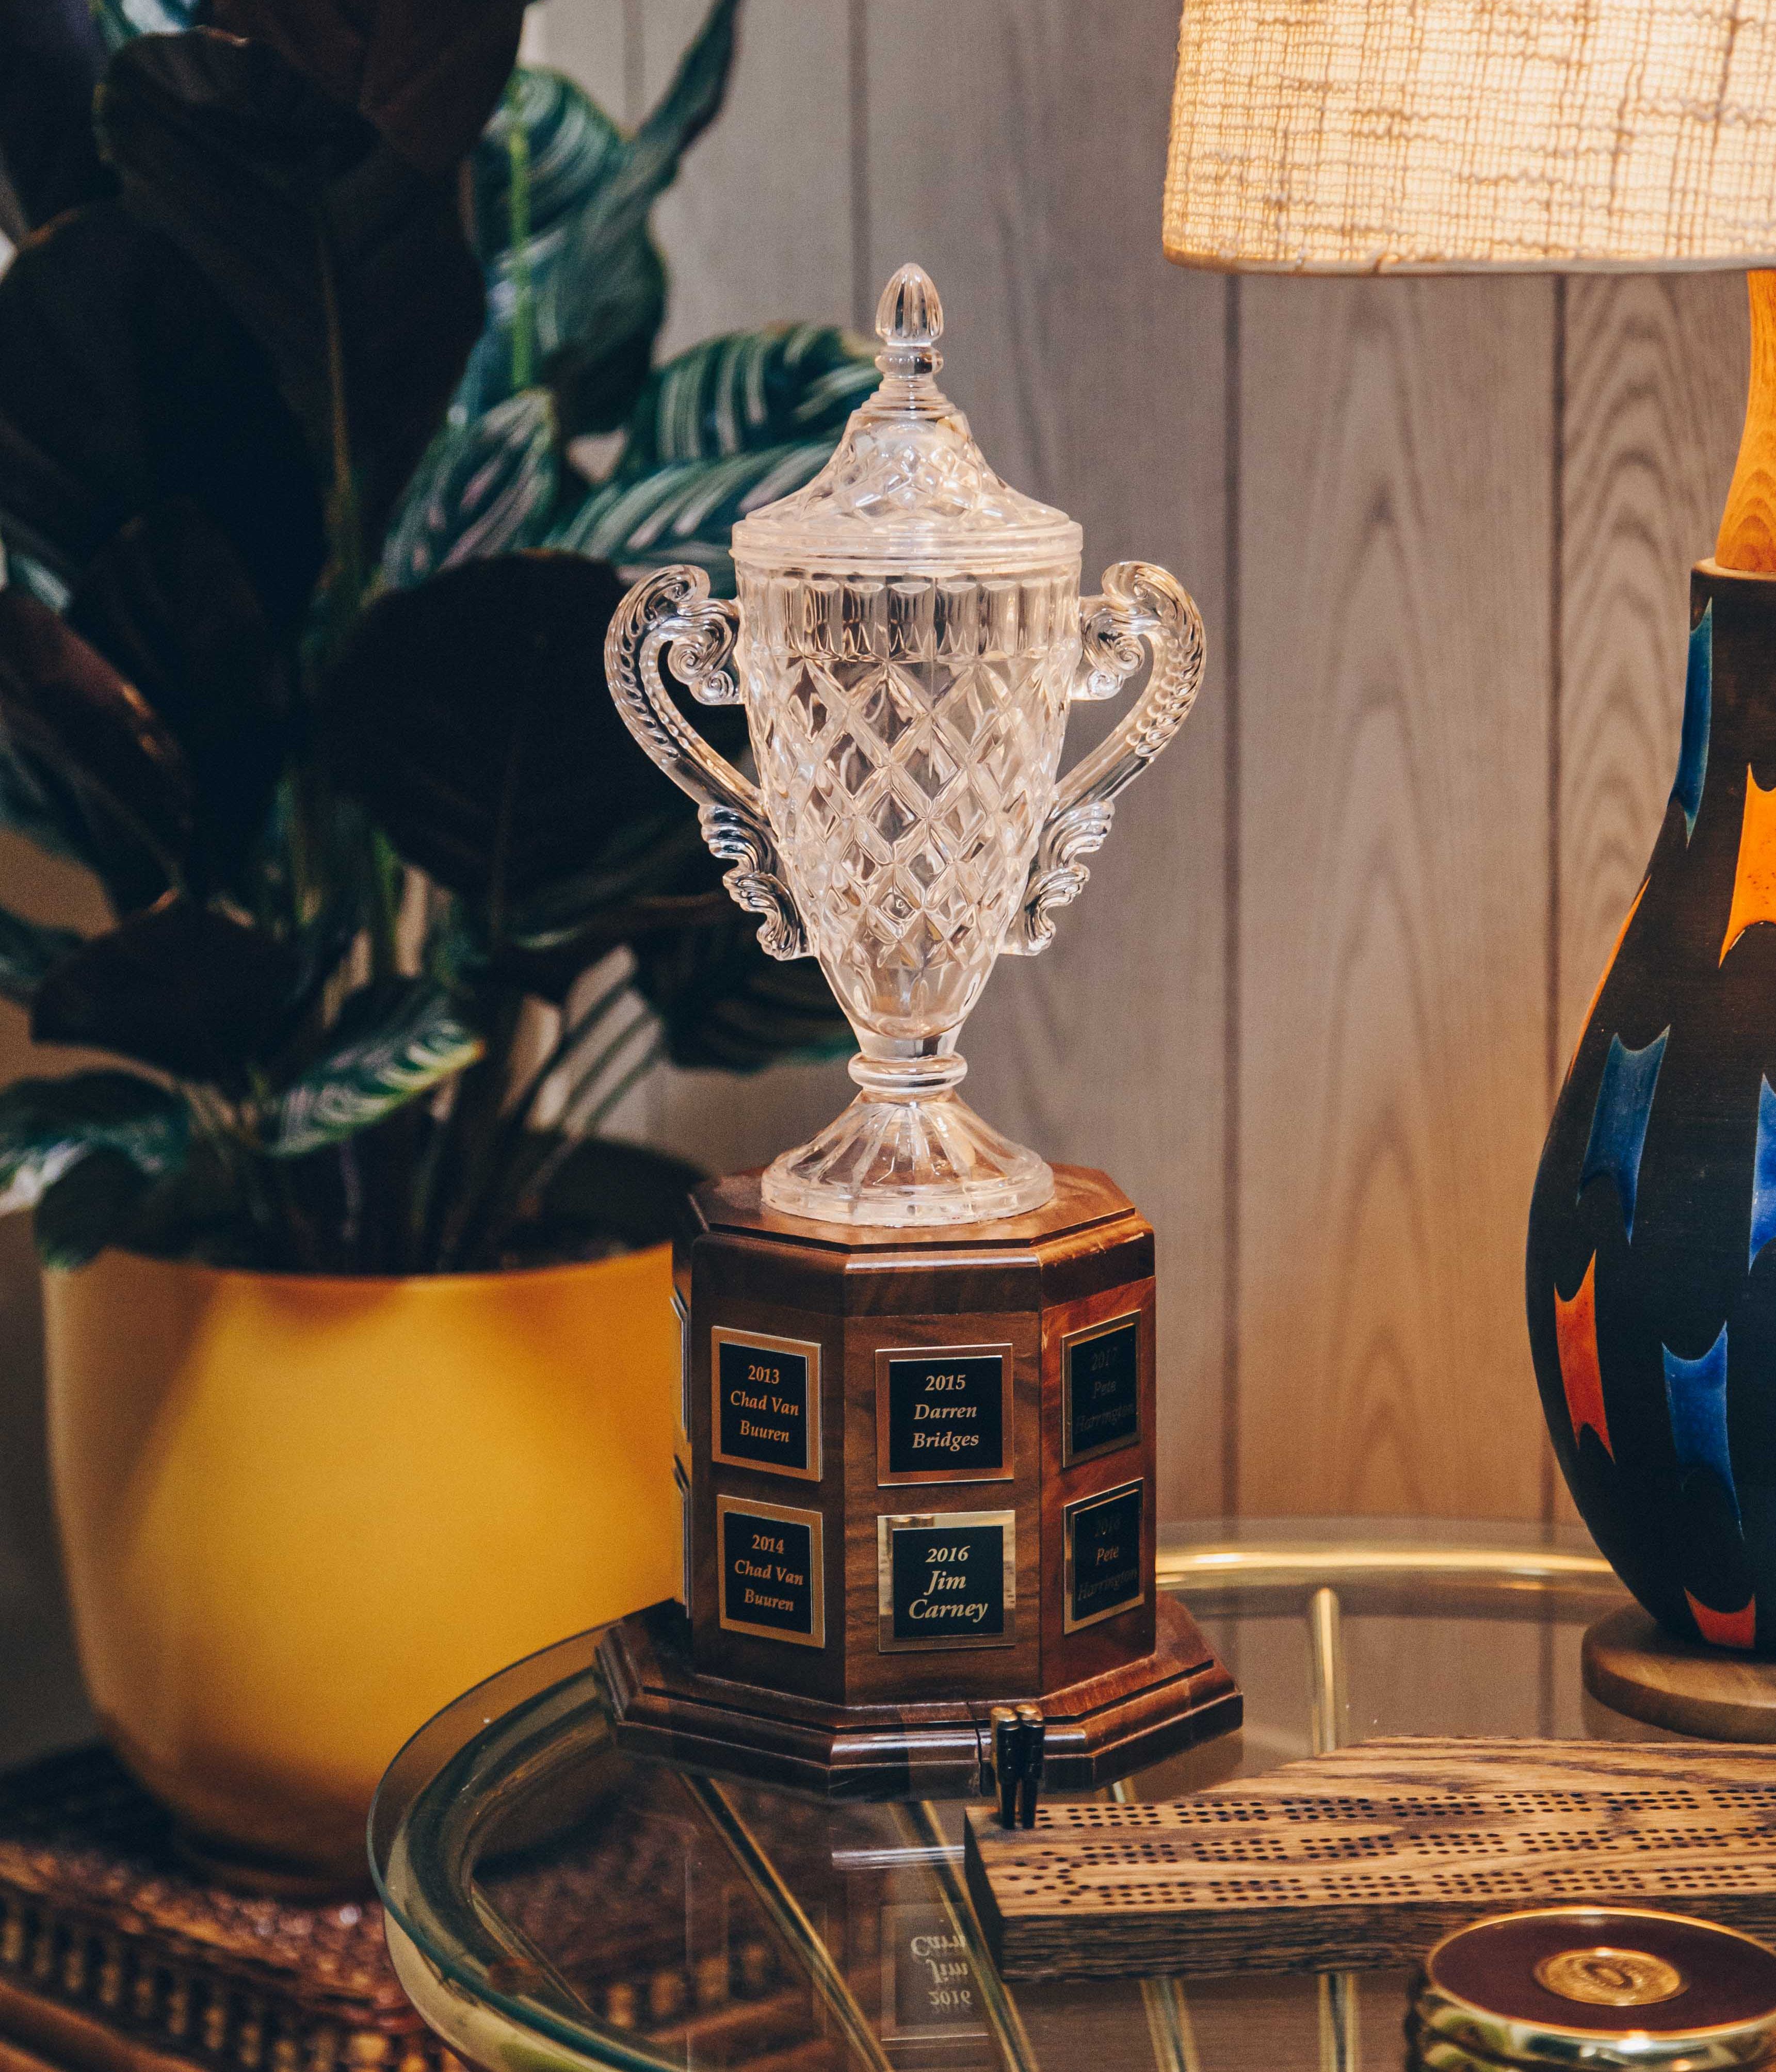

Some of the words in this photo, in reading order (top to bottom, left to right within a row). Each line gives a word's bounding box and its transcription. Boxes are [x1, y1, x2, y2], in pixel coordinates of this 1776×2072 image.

[748, 1365, 780, 1385] 2013
[925, 1374, 967, 1391] 2015
[1092, 1380, 1117, 1399] Pete
[731, 1390, 767, 1411] Chad
[771, 1396, 799, 1416] Van
[914, 1403, 977, 1420] Darren
[739, 1420, 790, 1443] Buuren
[912, 1431, 979, 1452] Bridges
[752, 1535, 784, 1555] 2014
[925, 1545, 971, 1563] 2016
[1095, 1545, 1120, 1566] Pete
[734, 1560, 772, 1580] Chad
[776, 1566, 804, 1586] Van
[924, 1570, 967, 1595] Jim
[744, 1588, 795, 1612] Buuren
[908, 1599, 989, 1623] Carney
